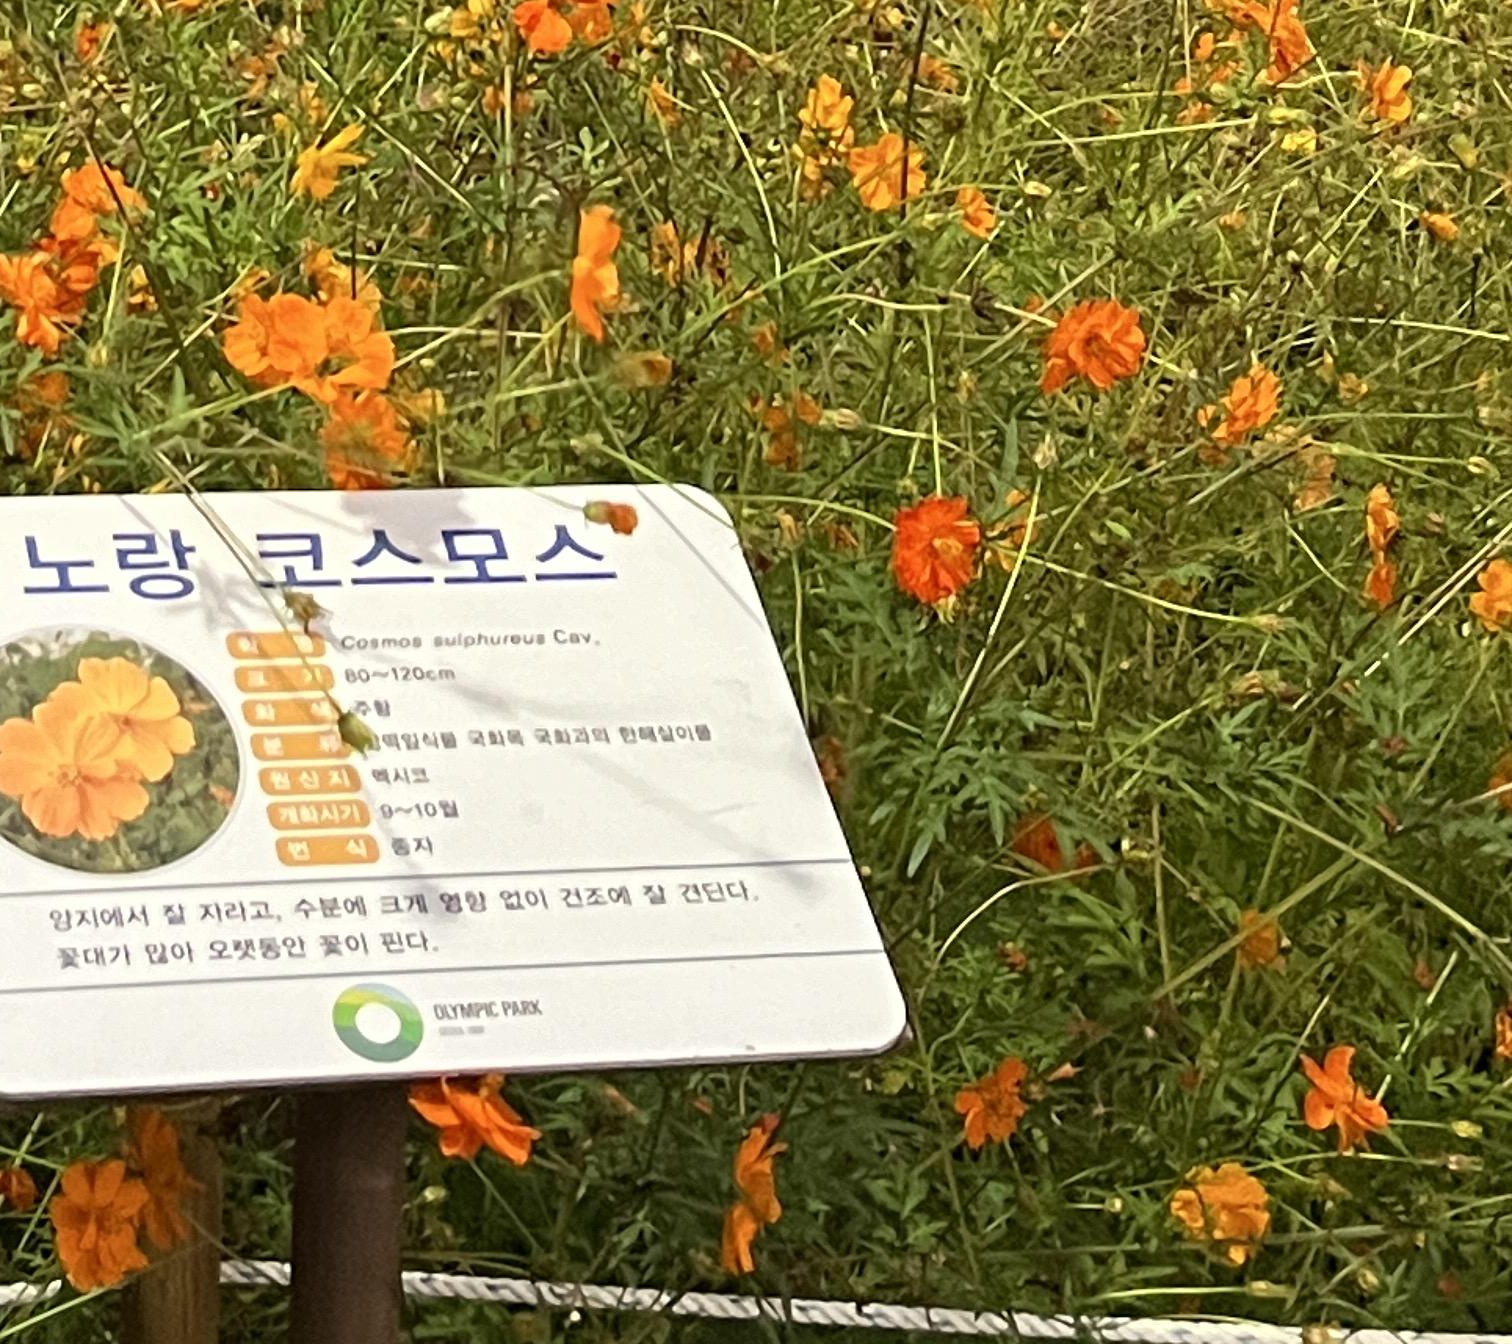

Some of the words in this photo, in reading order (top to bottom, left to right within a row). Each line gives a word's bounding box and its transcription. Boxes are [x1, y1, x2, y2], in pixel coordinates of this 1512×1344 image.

[23, 529, 196, 600] 노랑
[255, 524, 618, 589] 코스모스
[340, 634, 422, 651] Cosmos
[433, 631, 546, 650] sulphureus
[553, 628, 600, 647] Cav.
[372, 767, 430, 785] 멕시코
[279, 802, 360, 825] 개화시기
[392, 835, 434, 856] 종자
[49, 903, 150, 932] 양지에서
[163, 903, 186, 925] 잘
[199, 901, 282, 923] 자라고,
[294, 895, 368, 918] 수분에
[380, 893, 429, 914] 크게
[440, 891, 488, 913] 영향
[499, 888, 549, 911] 없이
[559, 885, 632, 908] 건조에
[643, 884, 666, 905] 잘
[678, 879, 760, 904] 견딘다.
[57, 943, 131, 970] 꽃대가
[144, 941, 195, 965] 많아
[208, 935, 307, 961] 오랫동안
[319, 932, 369, 958] 꽃이
[380, 929, 439, 954] 핀다.
[433, 1001, 500, 1021] OLYMPIC
[501, 999, 543, 1017] PARK
